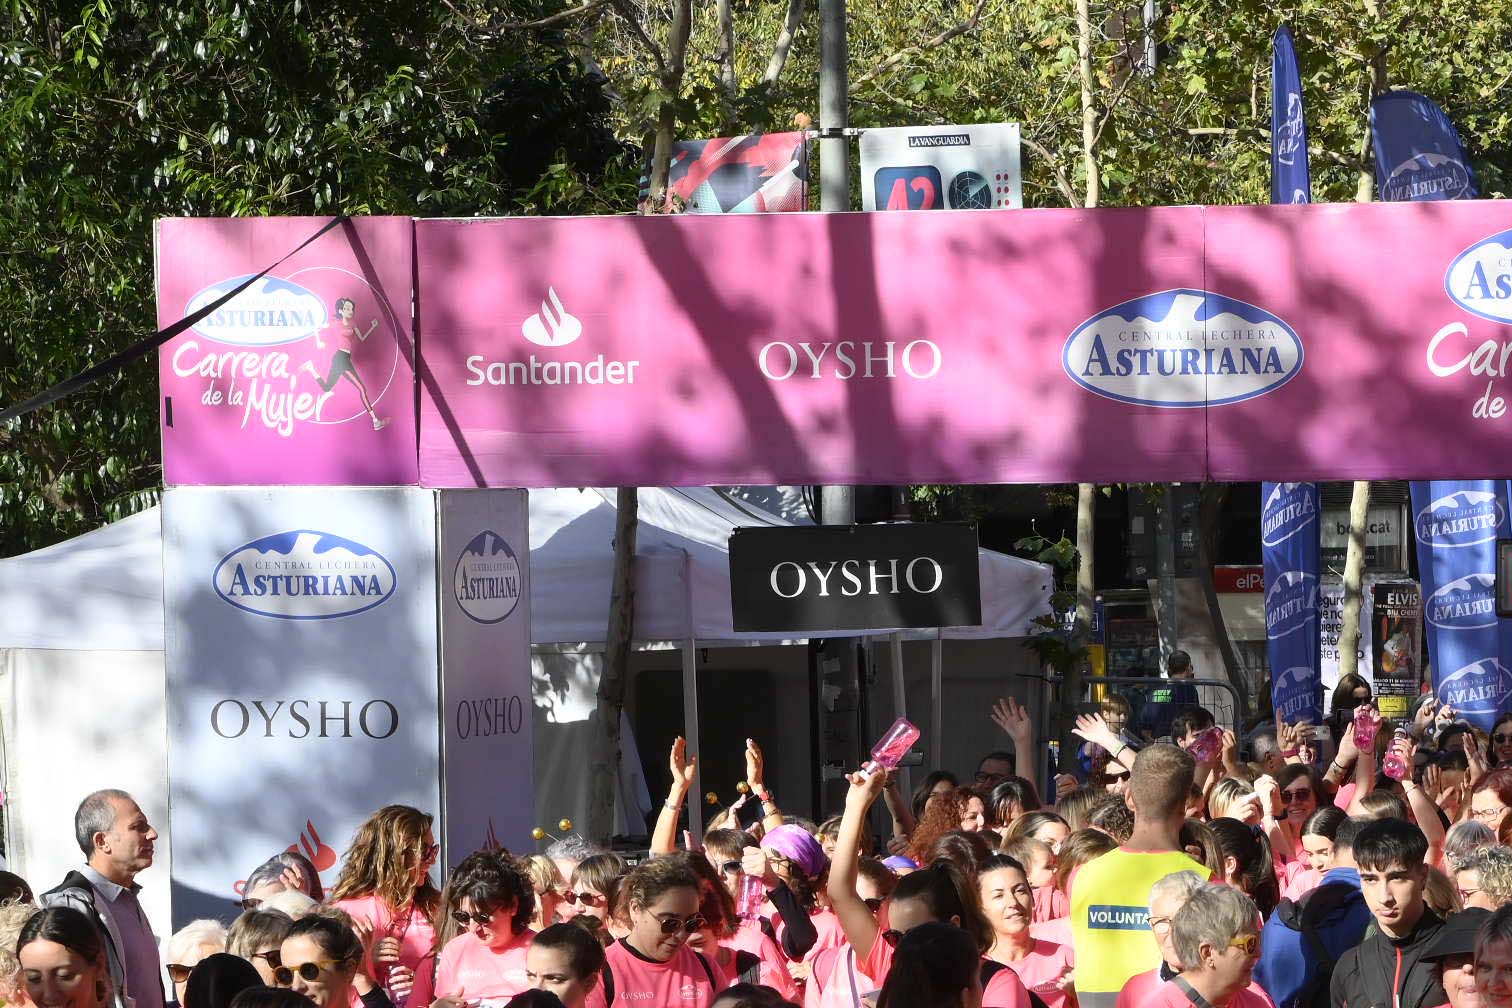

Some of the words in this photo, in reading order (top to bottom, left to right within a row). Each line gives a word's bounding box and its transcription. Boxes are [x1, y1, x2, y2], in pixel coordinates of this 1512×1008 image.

[1118, 330, 1193, 342] CENTRAL
[1202, 328, 1276, 340] LECHERA
[173, 340, 290, 379] Carrera
[467, 354, 640, 388] Santander
[758, 339, 942, 381] OYSHO
[1082, 335, 1285, 376] ASTURIANA
[201, 380, 223, 406] de
[228, 380, 244, 406] la
[241, 375, 335, 438] Mujer
[1472, 381, 1506, 419] de
[227, 563, 384, 596] ASTURIANA
[255, 560, 312, 569] CENTRAL
[770, 556, 943, 598] OYSHO
[459, 575, 517, 601] ASTURIANA
[1387, 593, 1418, 605] ELVIS
[211, 699, 399, 739] OYSHO
[456, 696, 523, 741] OYSHO
